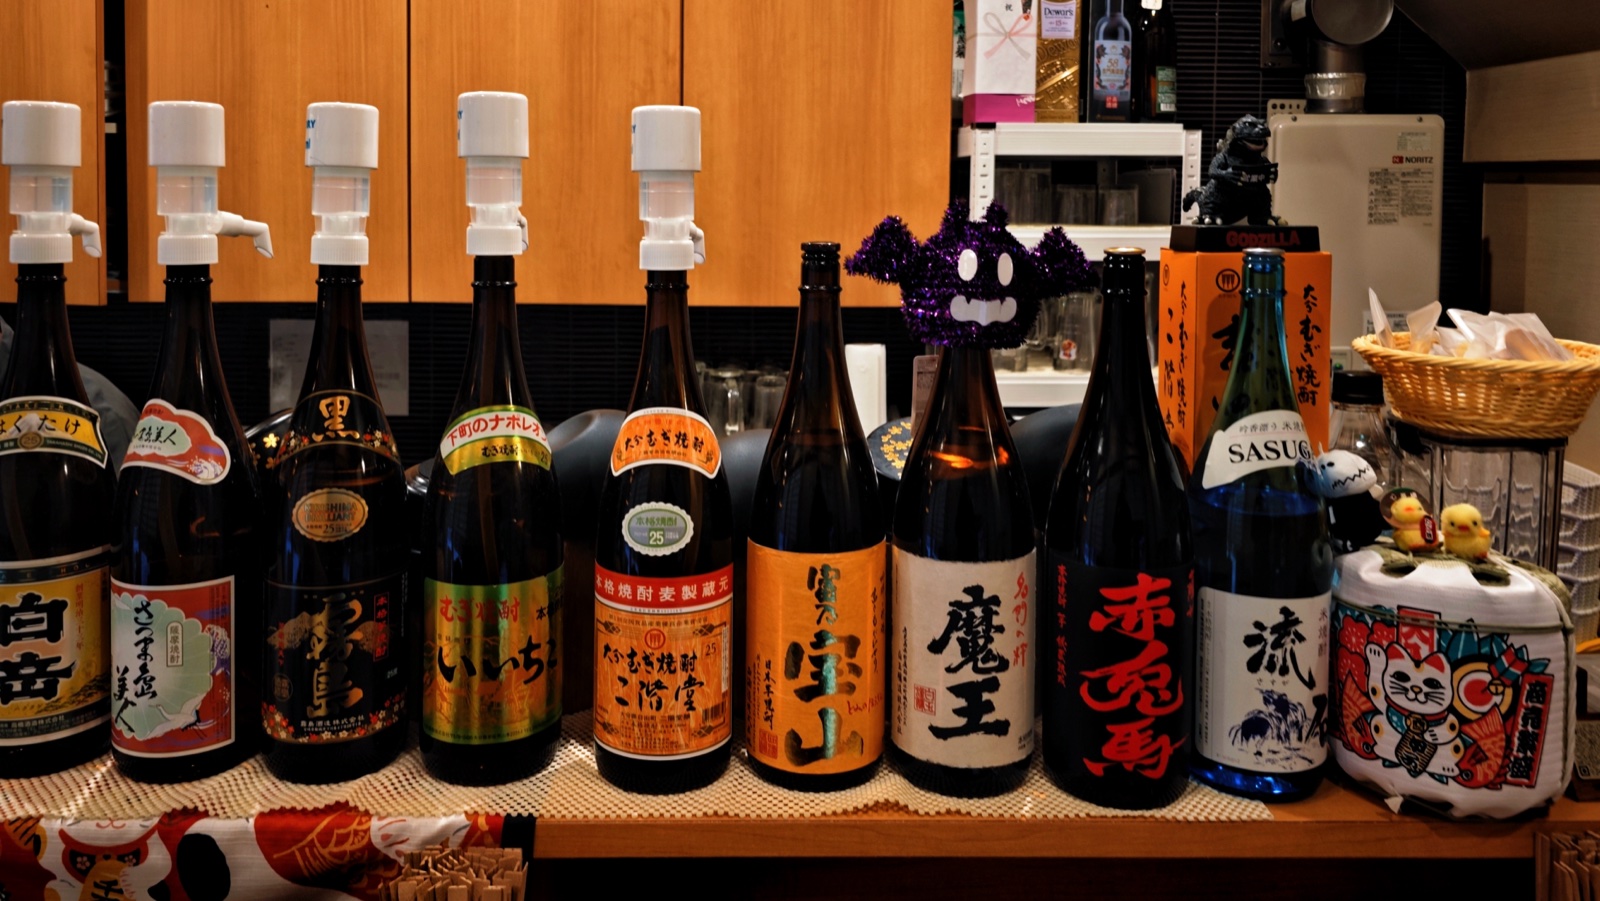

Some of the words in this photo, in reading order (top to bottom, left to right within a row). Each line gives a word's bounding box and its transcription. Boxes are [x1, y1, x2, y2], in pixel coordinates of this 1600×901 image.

[1044, 7, 1074, 17] Dewar's
[1405, 156, 1434, 164] NORITZ
[1226, 230, 1301, 248] GODZILLA
[1298, 283, 1322, 407] 大分むぎ焼酎
[311, 394, 361, 442] 黒
[1228, 439, 1316, 464] SASUG
[322, 524, 335, 535] 25
[649, 531, 664, 546] 25
[595, 574, 729, 602] 本格焼酎麦製蔵元
[439, 595, 521, 624] むぎ焼酎
[0, 591, 77, 706] 白岳
[169, 625, 180, 664] 薩摩焼酎
[704, 642, 717, 657] 25
[437, 635, 558, 685] いいちこ
[926, 584, 1011, 741] 魔王
